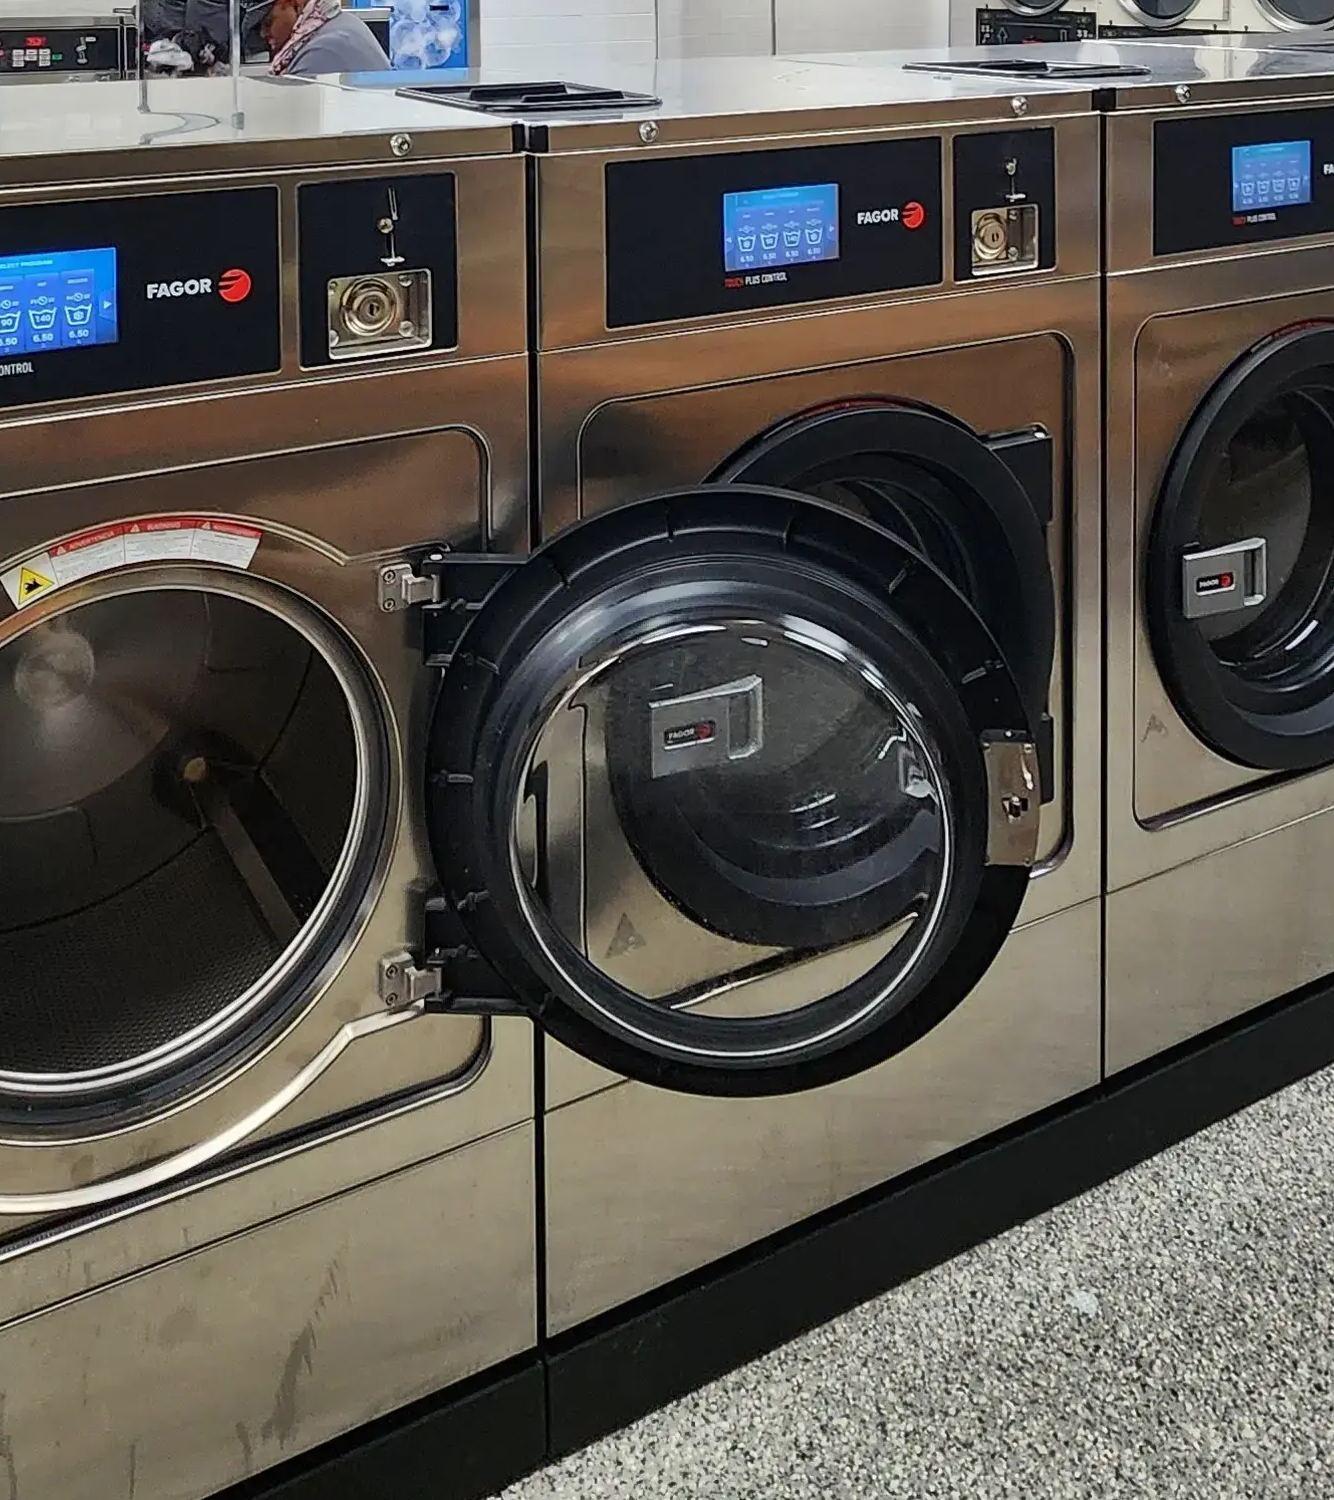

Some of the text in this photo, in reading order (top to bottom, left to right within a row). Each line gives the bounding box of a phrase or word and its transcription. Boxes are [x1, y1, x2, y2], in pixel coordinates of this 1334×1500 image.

[857, 208, 899, 225] FAGOR
[745, 274, 760, 286] PLUS
[761, 271, 788, 284] CONTROL
[147, 275, 213, 301] FAGOR
[32, 332, 54, 342] 6.50
[69, 328, 90, 339] 6.50
